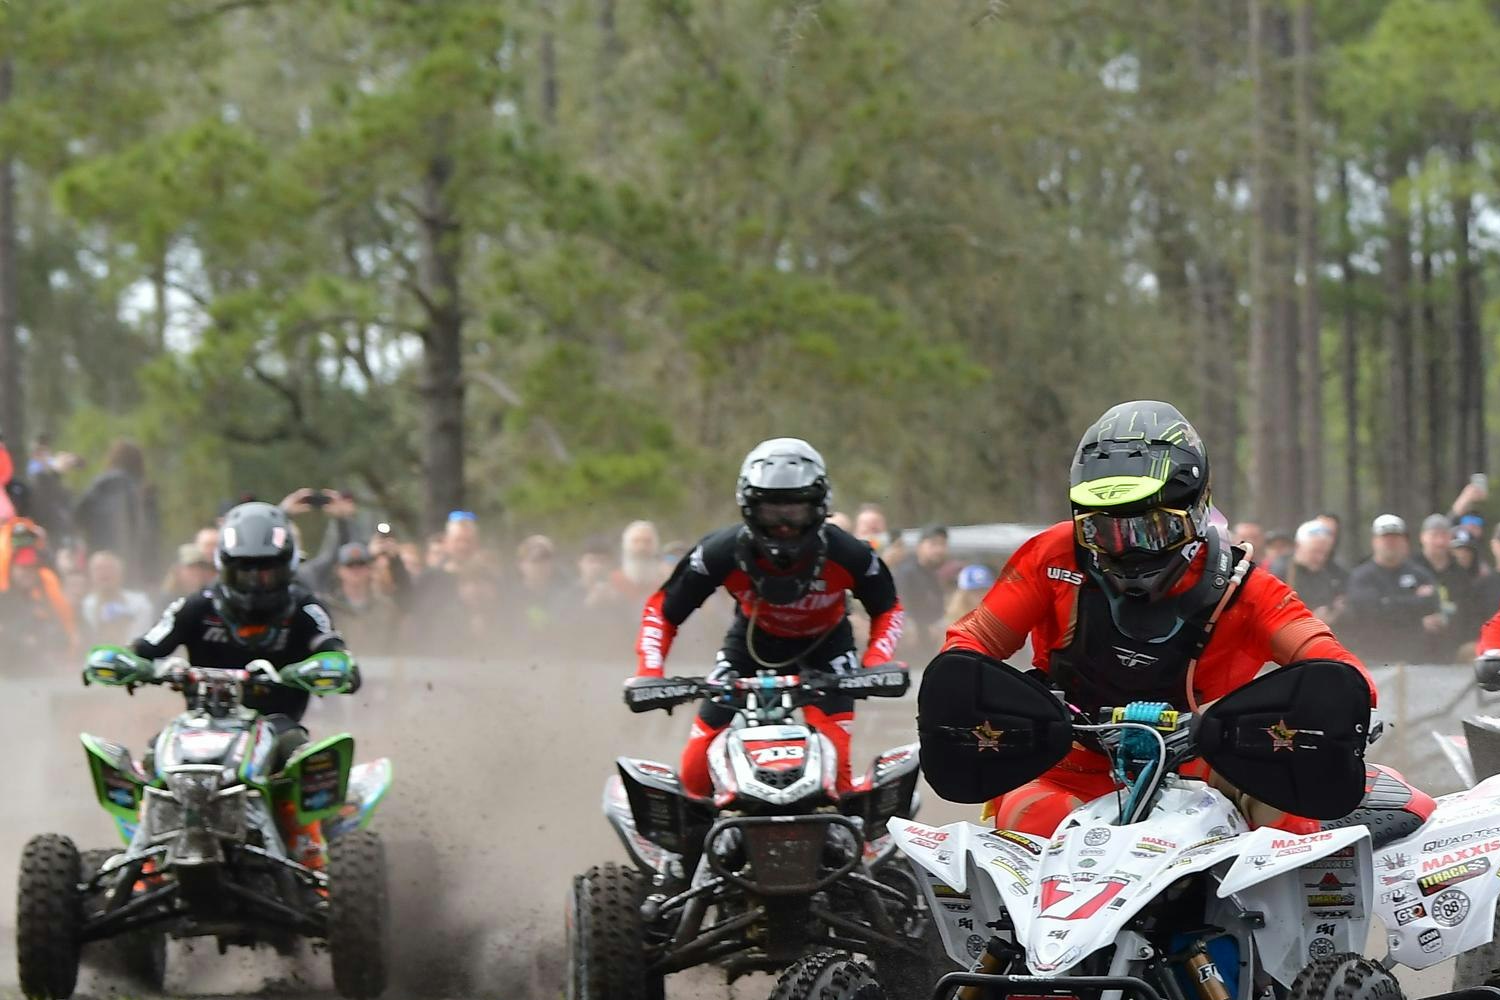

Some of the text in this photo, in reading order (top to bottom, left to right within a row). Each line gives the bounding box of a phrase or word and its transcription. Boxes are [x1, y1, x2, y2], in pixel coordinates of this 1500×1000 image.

[1047, 567, 1084, 586] WPS
[1141, 836, 1178, 849] MAXXIS
[1271, 832, 1333, 850] MAXXIS
[1420, 864, 1469, 889] ITHACA
[1444, 901, 1460, 917] 88
[1420, 930, 1440, 944] ICON
